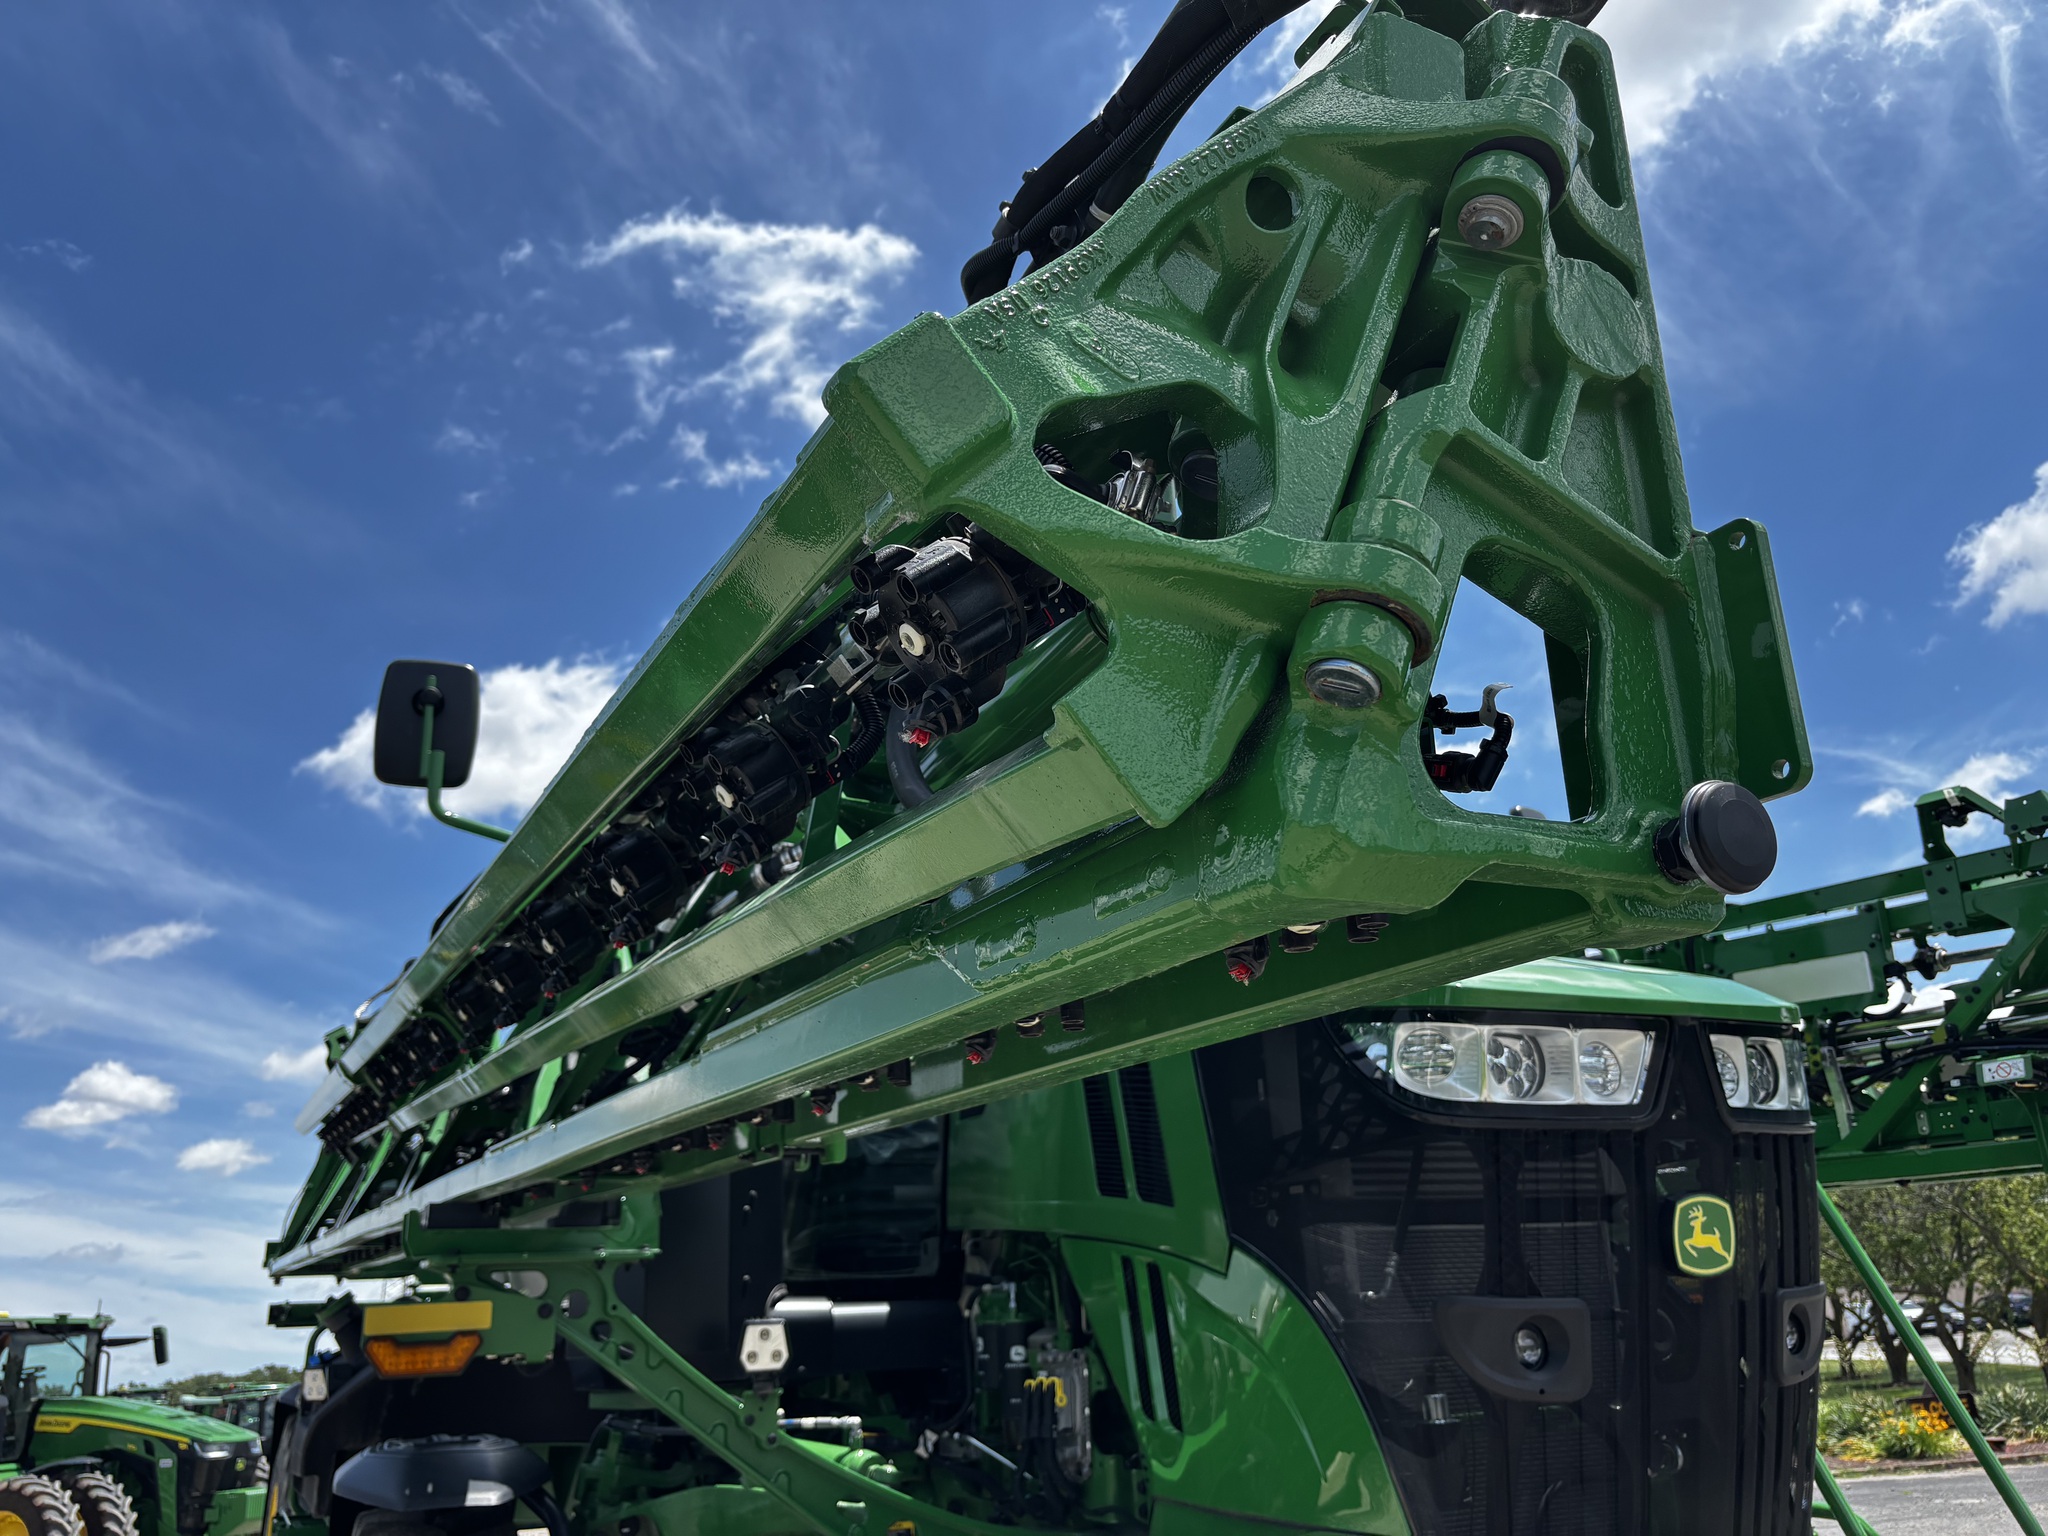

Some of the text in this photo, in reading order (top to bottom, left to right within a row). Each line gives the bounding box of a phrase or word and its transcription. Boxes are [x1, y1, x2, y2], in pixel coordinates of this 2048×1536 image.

[1149, 120, 1268, 206] KK99122 RAW
[1032, 239, 1113, 300] KK99126
[982, 285, 1031, 324] USA
